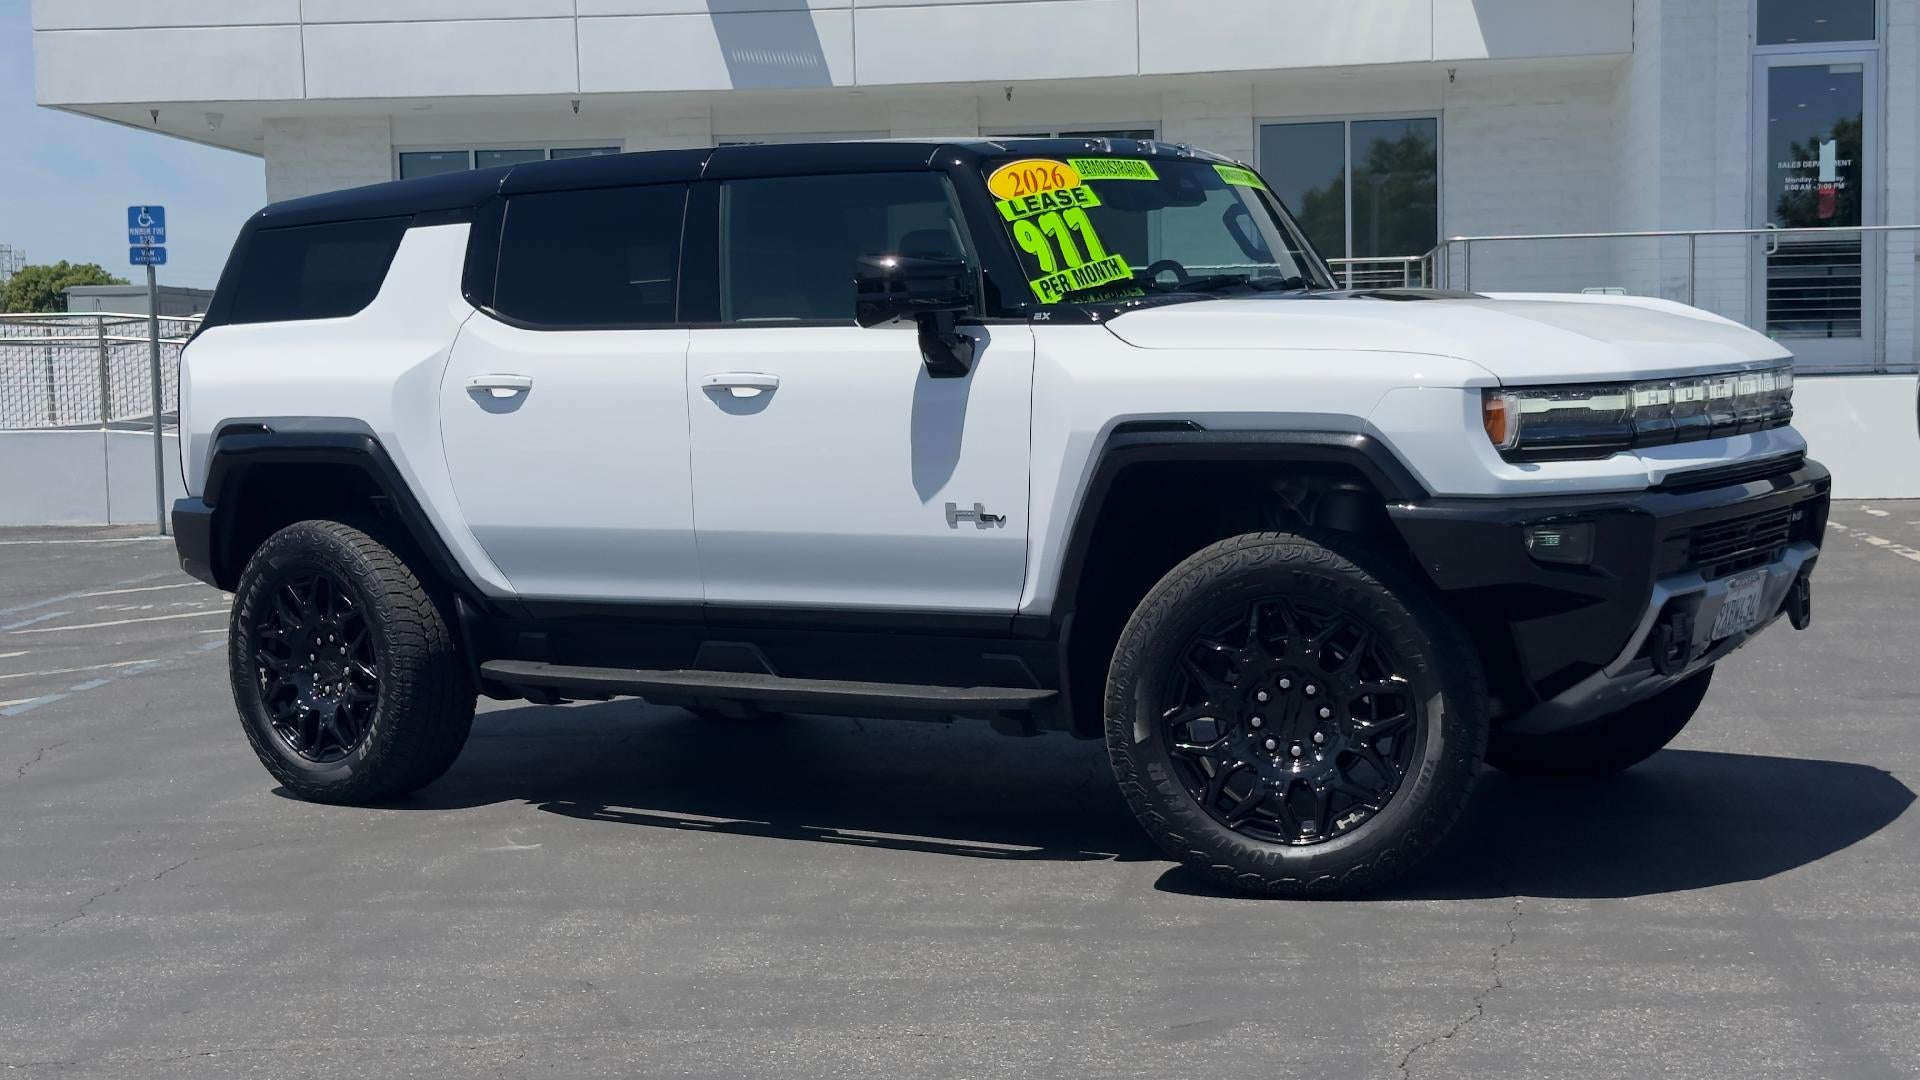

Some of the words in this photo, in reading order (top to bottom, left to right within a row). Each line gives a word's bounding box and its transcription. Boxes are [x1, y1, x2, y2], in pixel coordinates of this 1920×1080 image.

[1777, 161, 1801, 169] SALES
[1007, 165, 1065, 197] 2026
[1008, 187, 1089, 217] LEASE
[1039, 275, 1072, 300] PER
[1071, 258, 1122, 288] MONTH
